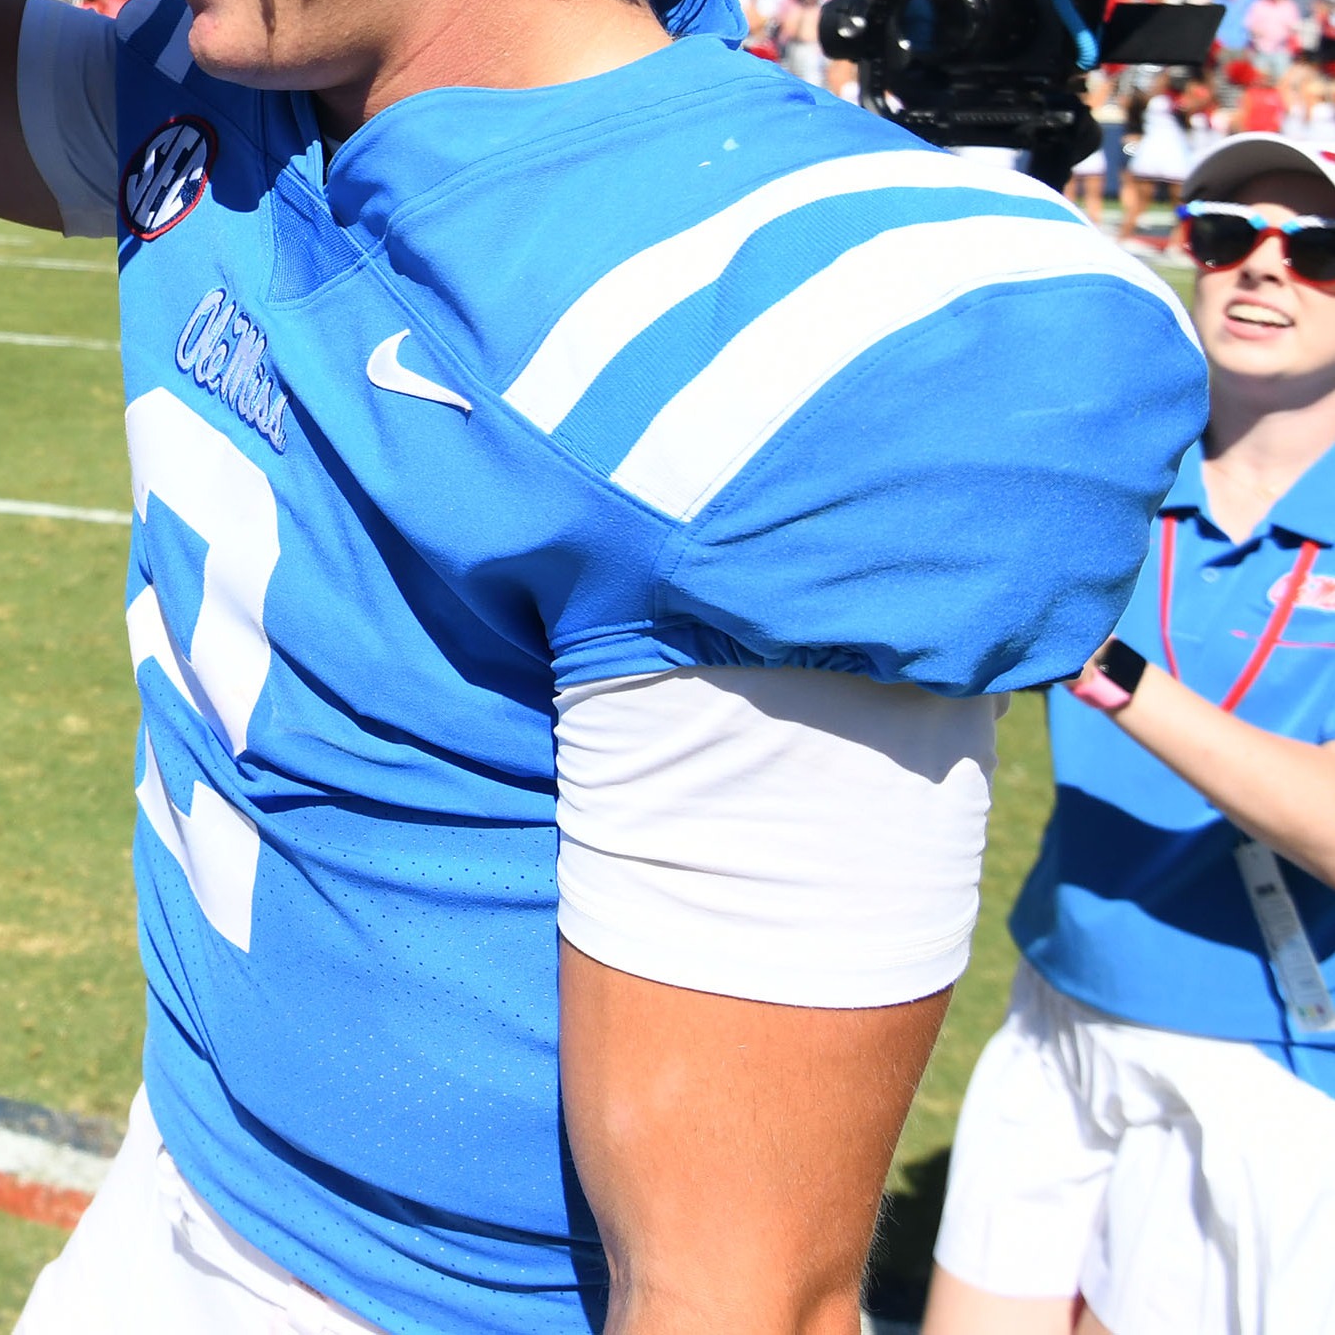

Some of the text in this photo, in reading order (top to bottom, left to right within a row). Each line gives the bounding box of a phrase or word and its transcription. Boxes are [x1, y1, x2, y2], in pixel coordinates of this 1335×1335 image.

[126, 122, 208, 232] SEC
[174, 286, 290, 455] Ole Miss
